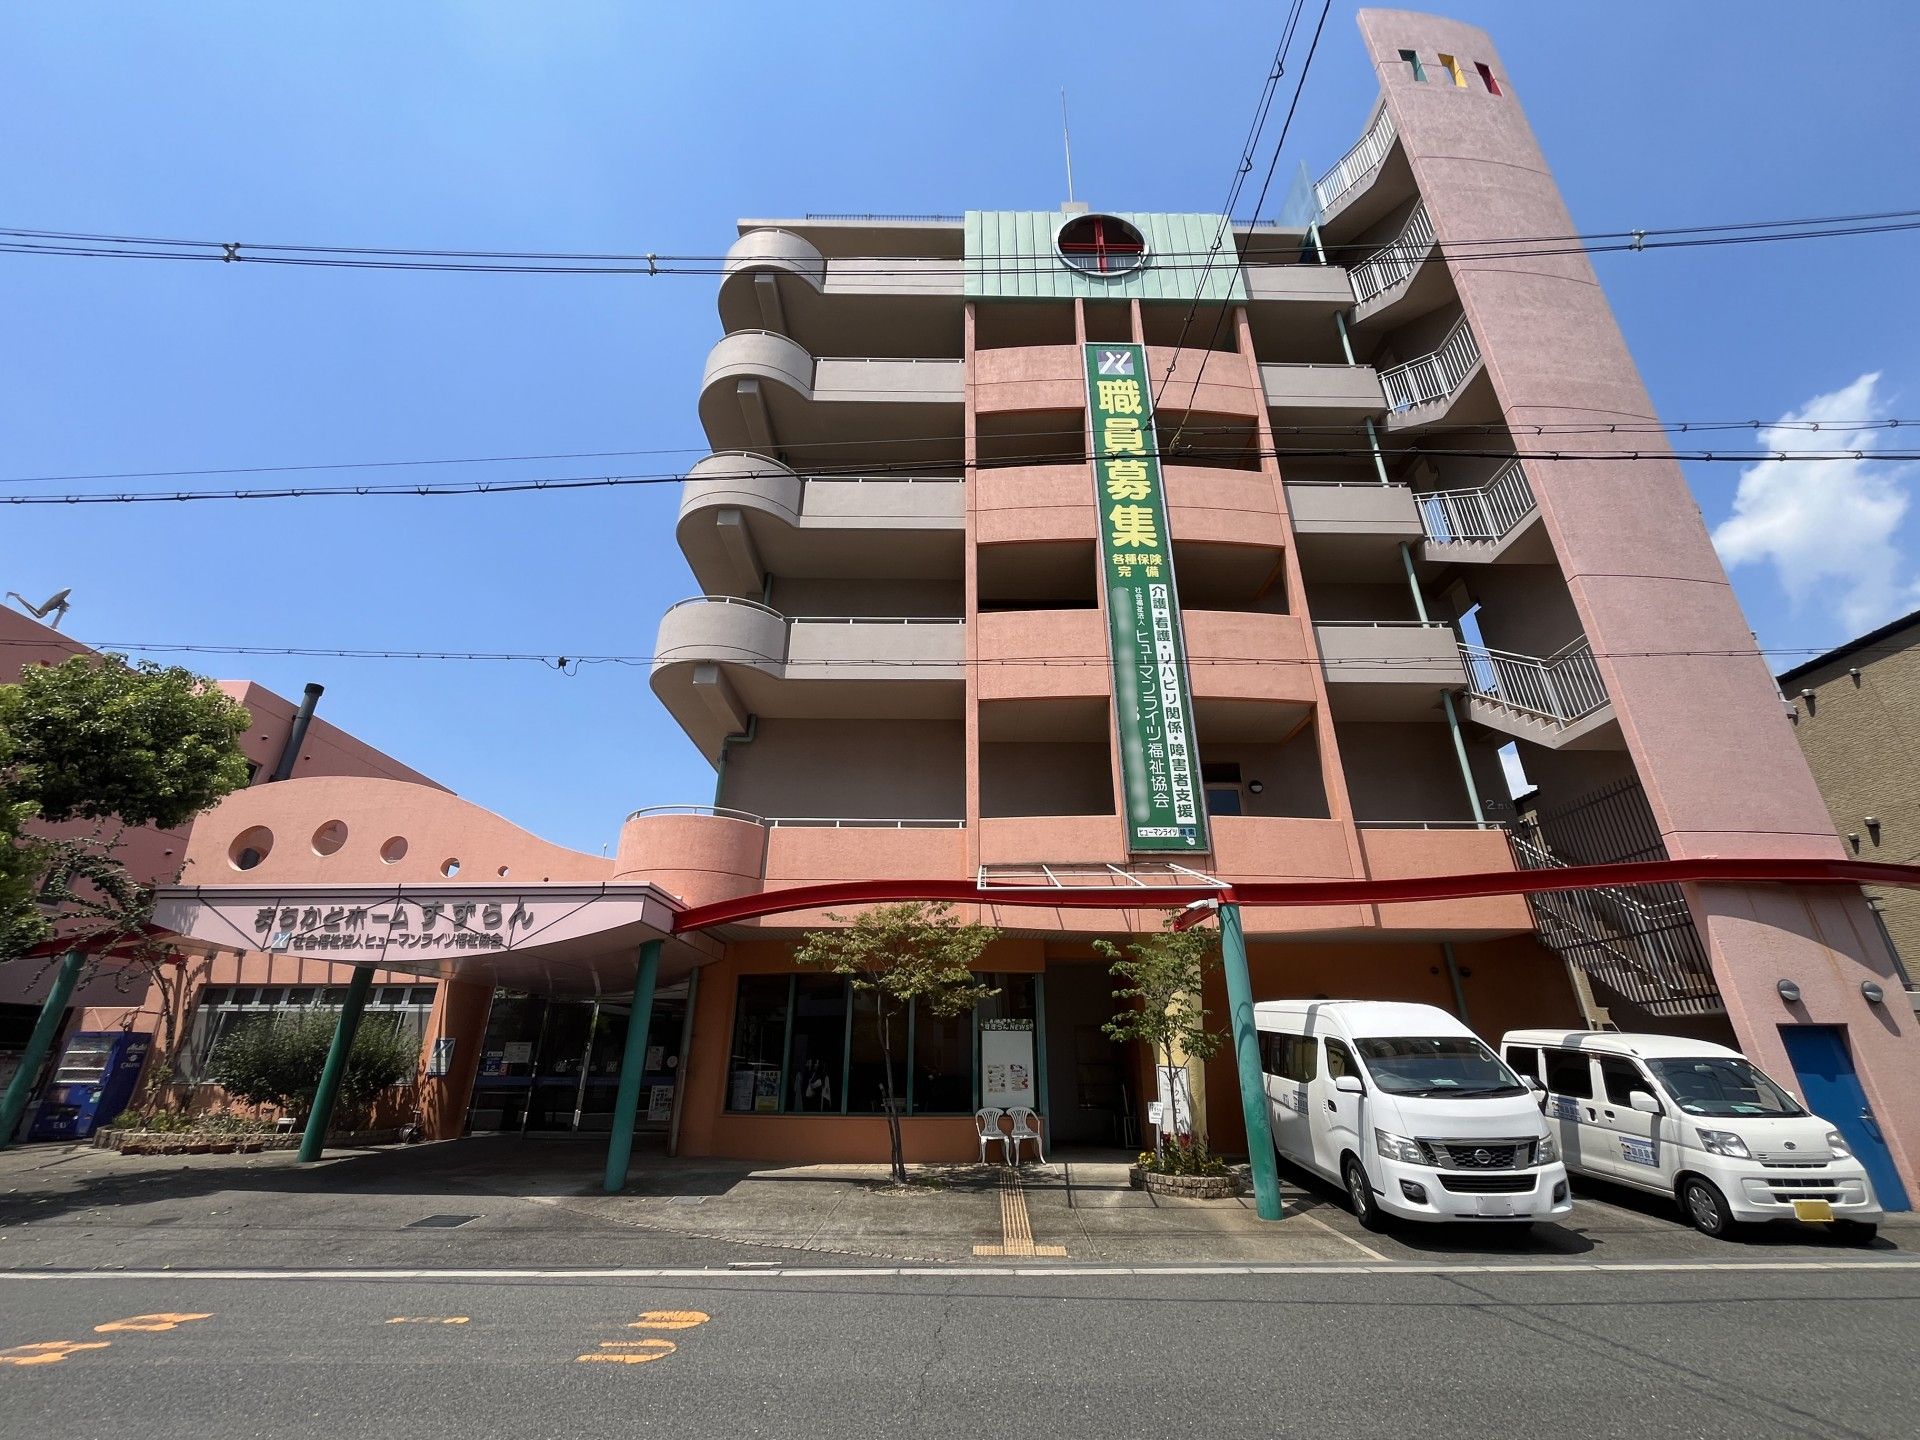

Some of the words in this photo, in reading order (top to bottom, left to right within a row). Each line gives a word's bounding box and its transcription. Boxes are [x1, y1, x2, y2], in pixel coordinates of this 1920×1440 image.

[1097, 379, 1158, 547] 職員募集
[1112, 553, 1163, 566] 各種保険
[421, 901, 534, 932] すずらん
